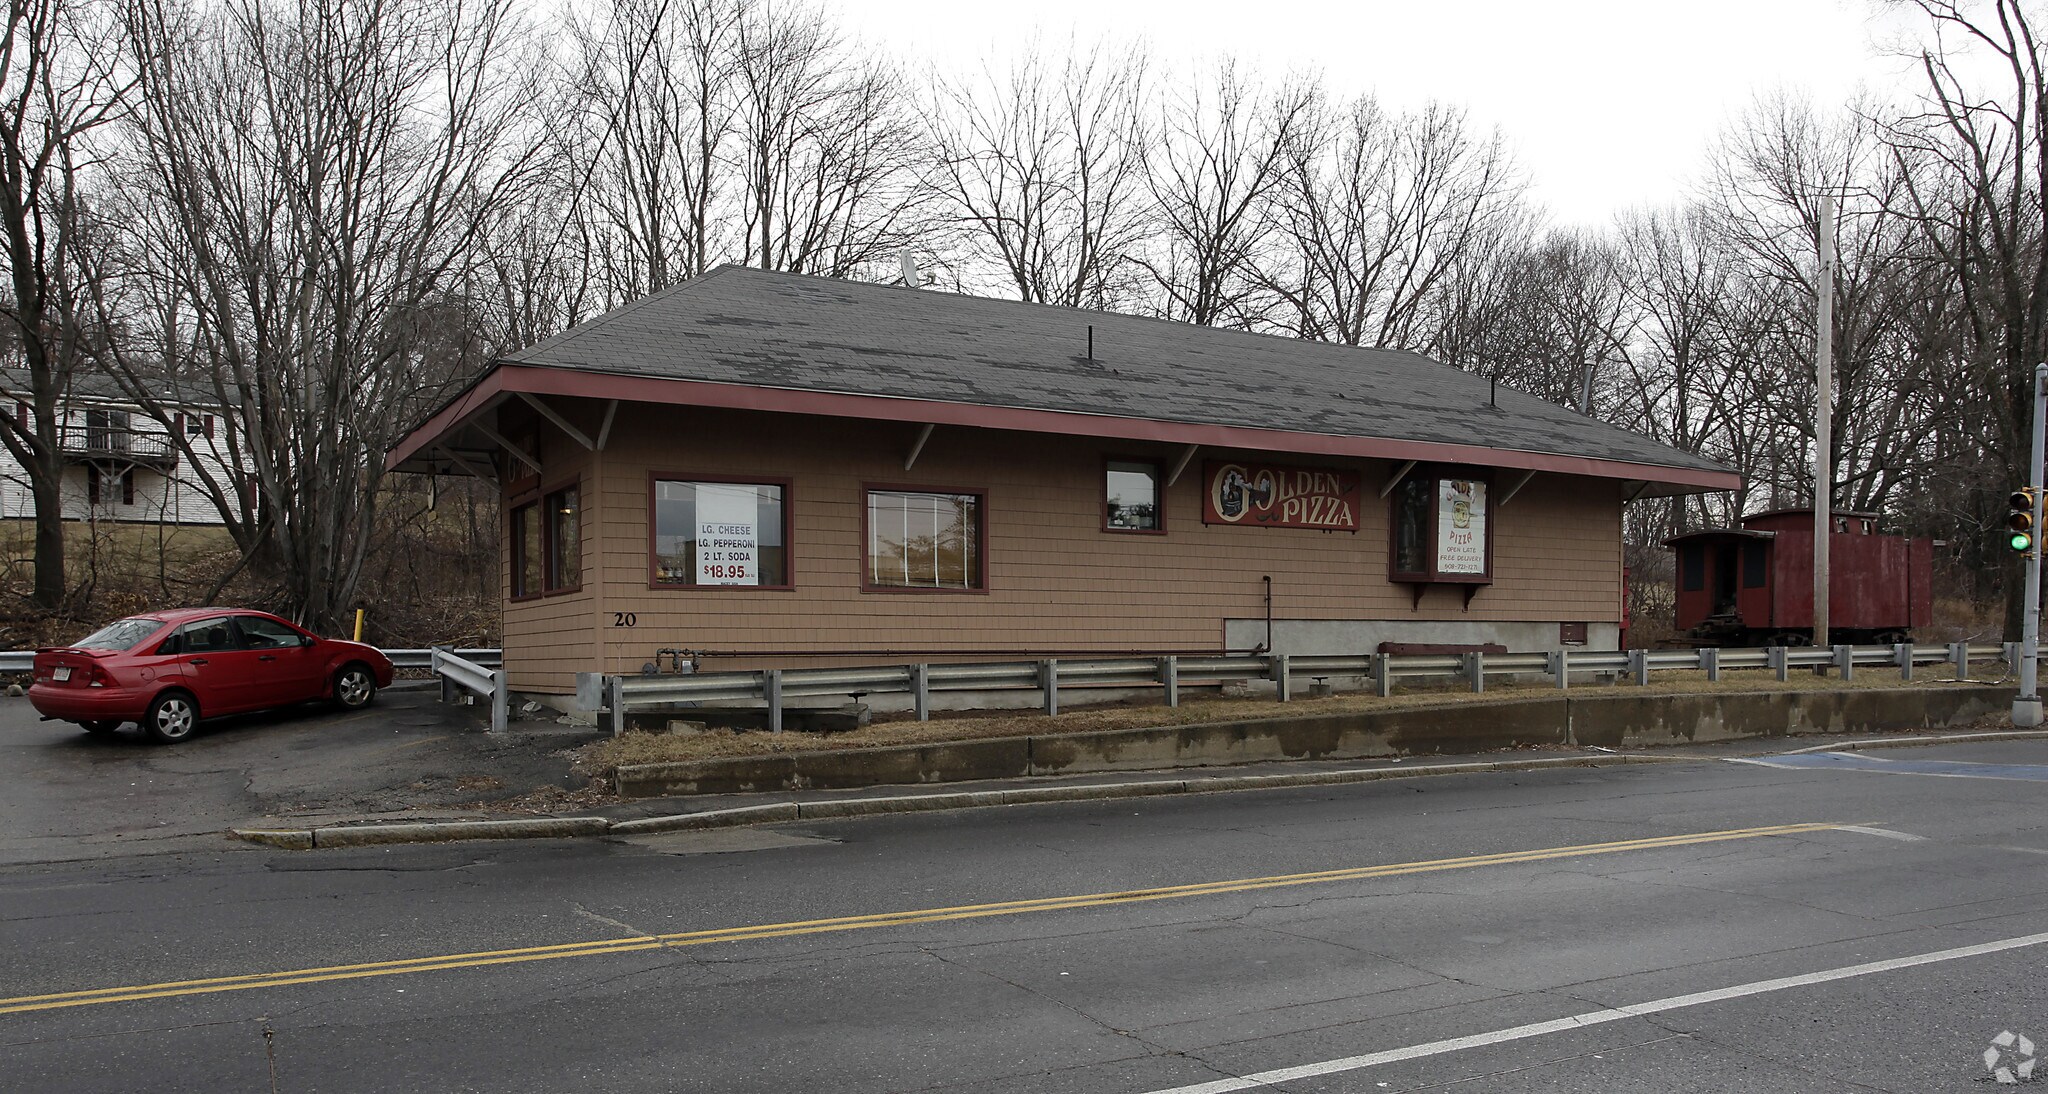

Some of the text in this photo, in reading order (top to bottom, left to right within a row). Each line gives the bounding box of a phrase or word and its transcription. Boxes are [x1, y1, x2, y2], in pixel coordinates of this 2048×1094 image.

[1282, 495, 1354, 526] PIZZA
[702, 525, 751, 535] LG. CHEESE
[698, 538, 755, 548] LG. PEPPERONI
[1449, 530, 1473, 545] PIZZA
[704, 552, 751, 561] 2 LT. SODA
[703, 564, 745, 578] $18.95
[614, 612, 637, 627] 20
